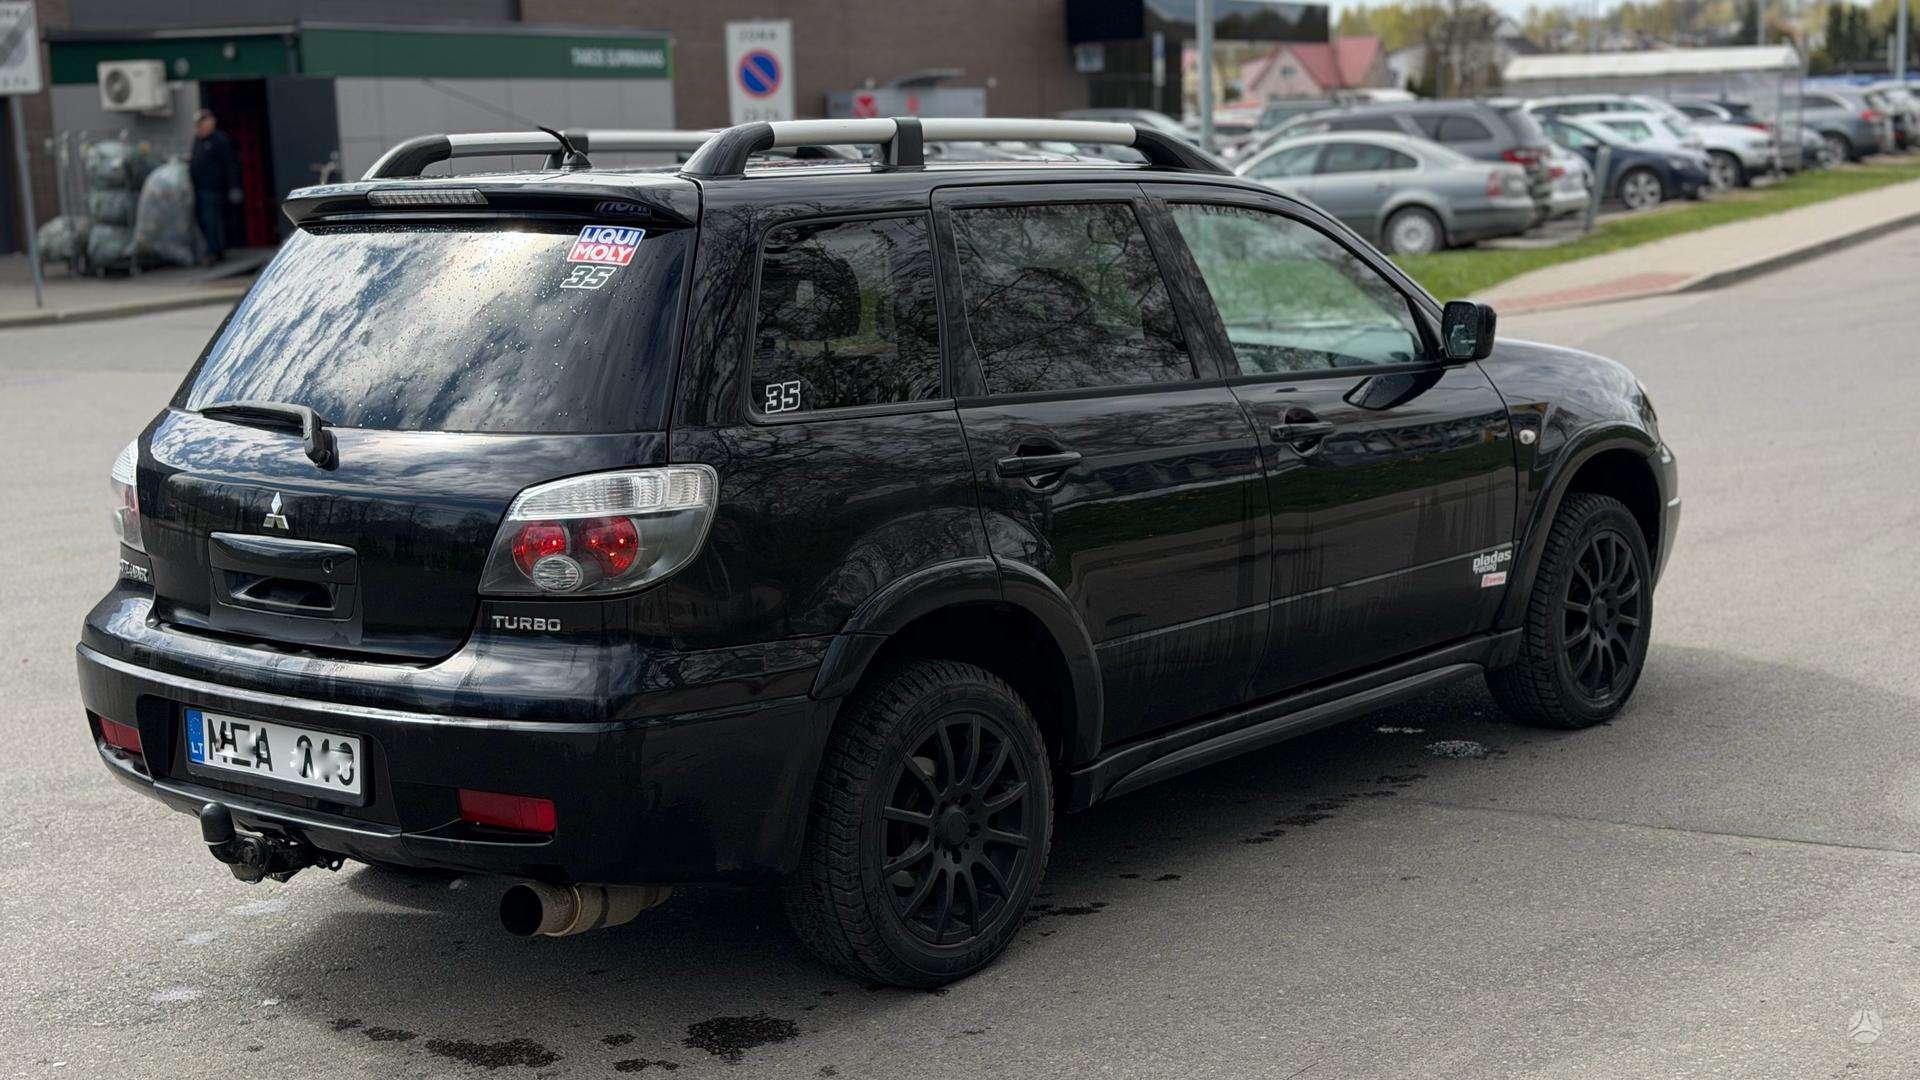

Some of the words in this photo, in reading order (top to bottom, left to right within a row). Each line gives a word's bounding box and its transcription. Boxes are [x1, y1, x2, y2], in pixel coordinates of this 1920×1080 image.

[581, 228, 641, 245] LIQUI
[573, 244, 633, 262] MOLY
[560, 265, 618, 289] 35
[765, 380, 801, 414] 35
[492, 615, 561, 631] TURBO
[191, 742, 203, 754] LT
